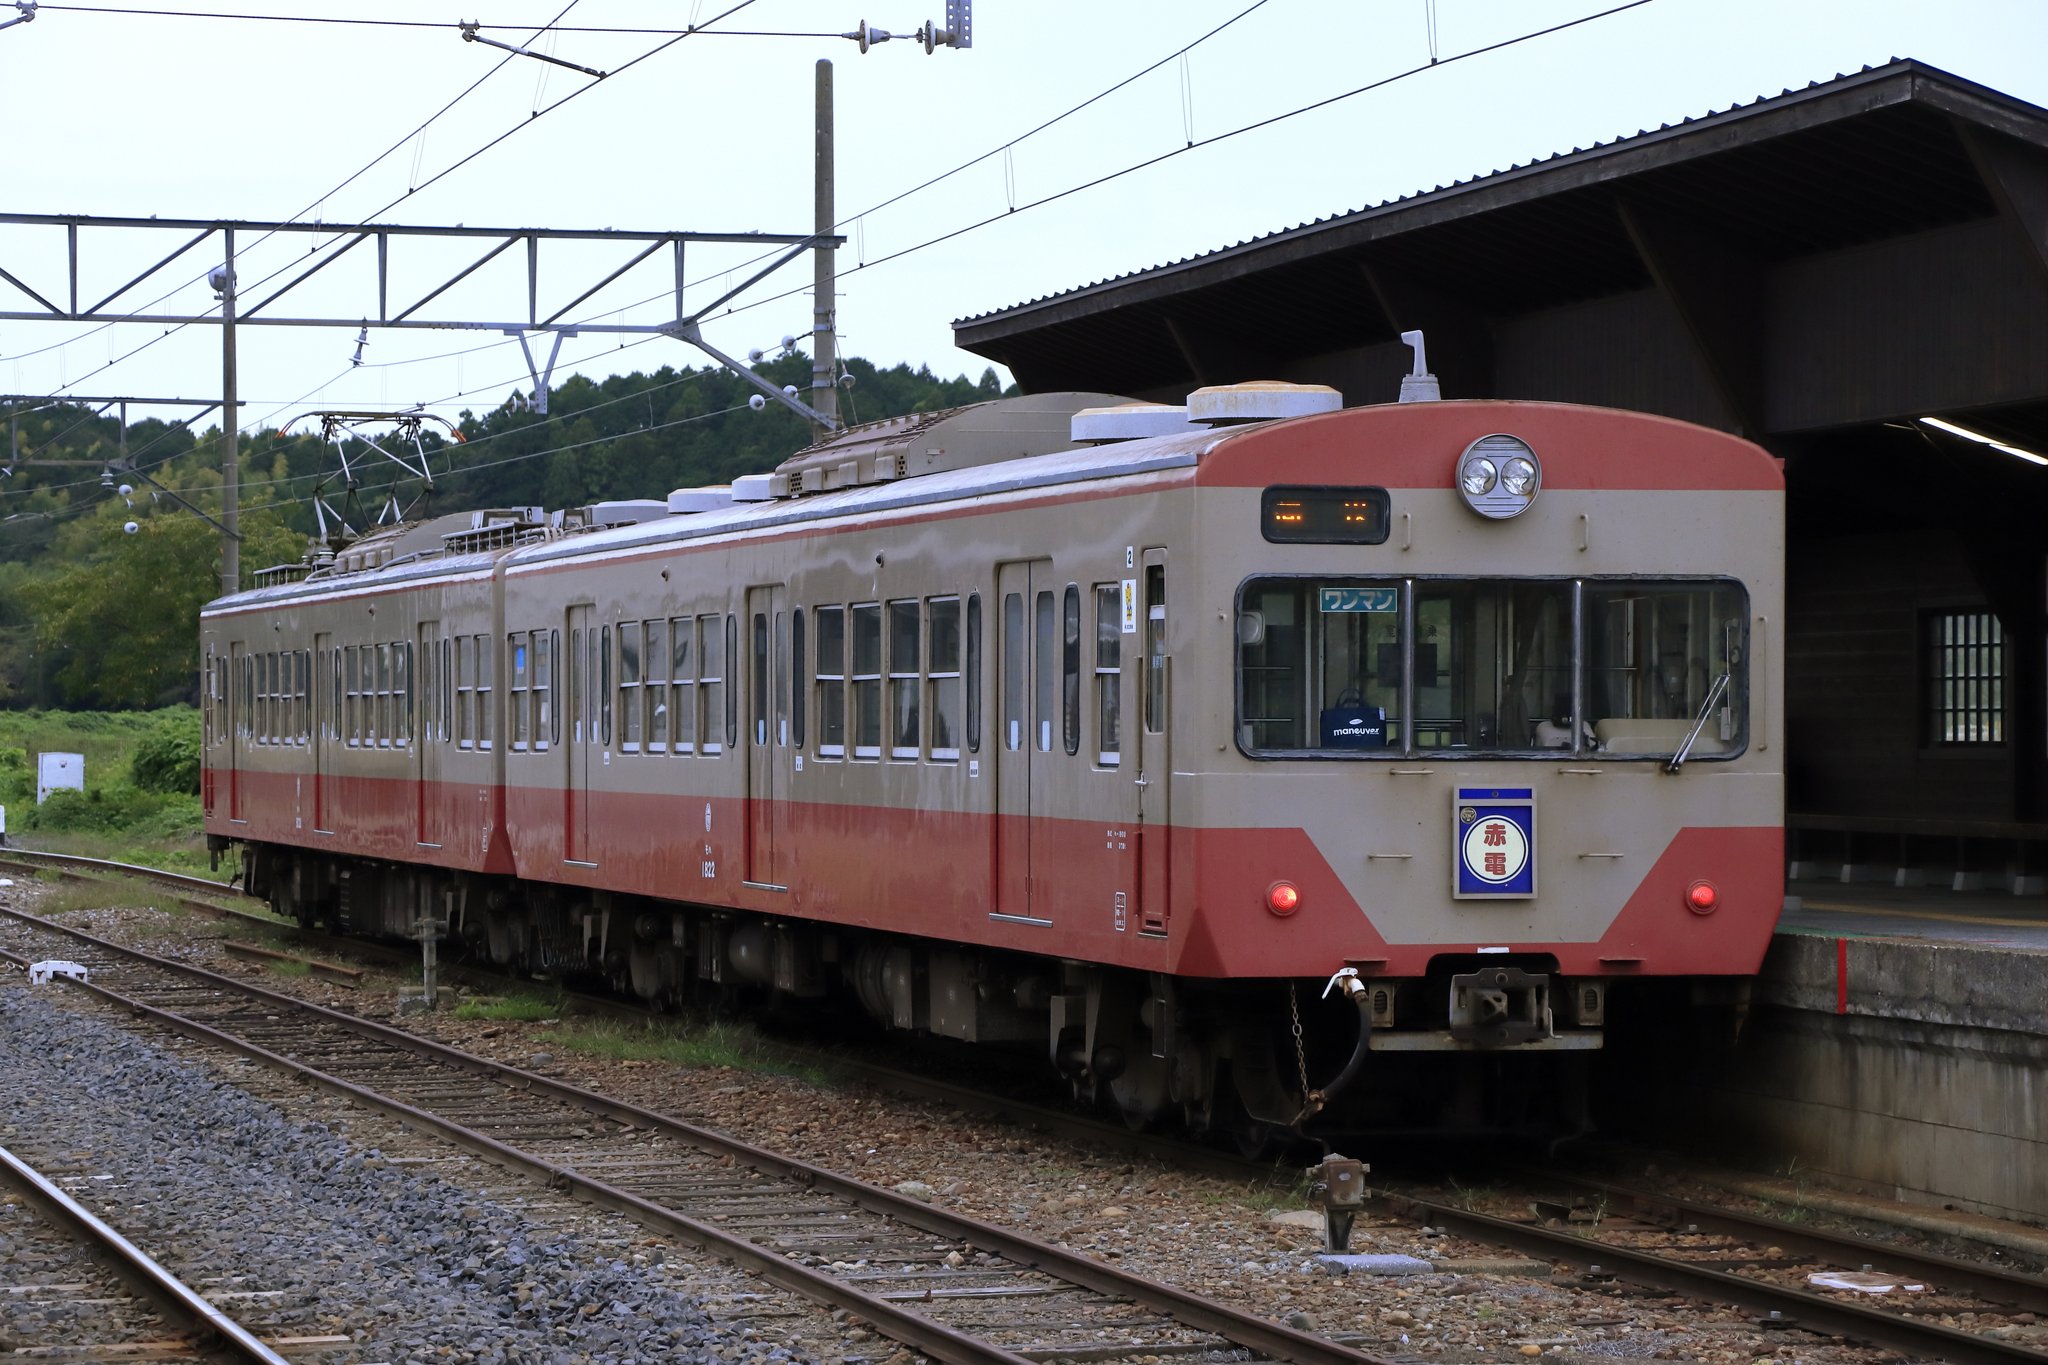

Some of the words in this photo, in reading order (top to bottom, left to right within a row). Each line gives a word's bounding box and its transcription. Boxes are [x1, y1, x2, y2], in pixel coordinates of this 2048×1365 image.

[1325, 590, 1393, 610] ワンマン
[1484, 823, 1507, 876] 赤電
[701, 861, 716, 878] 1822
